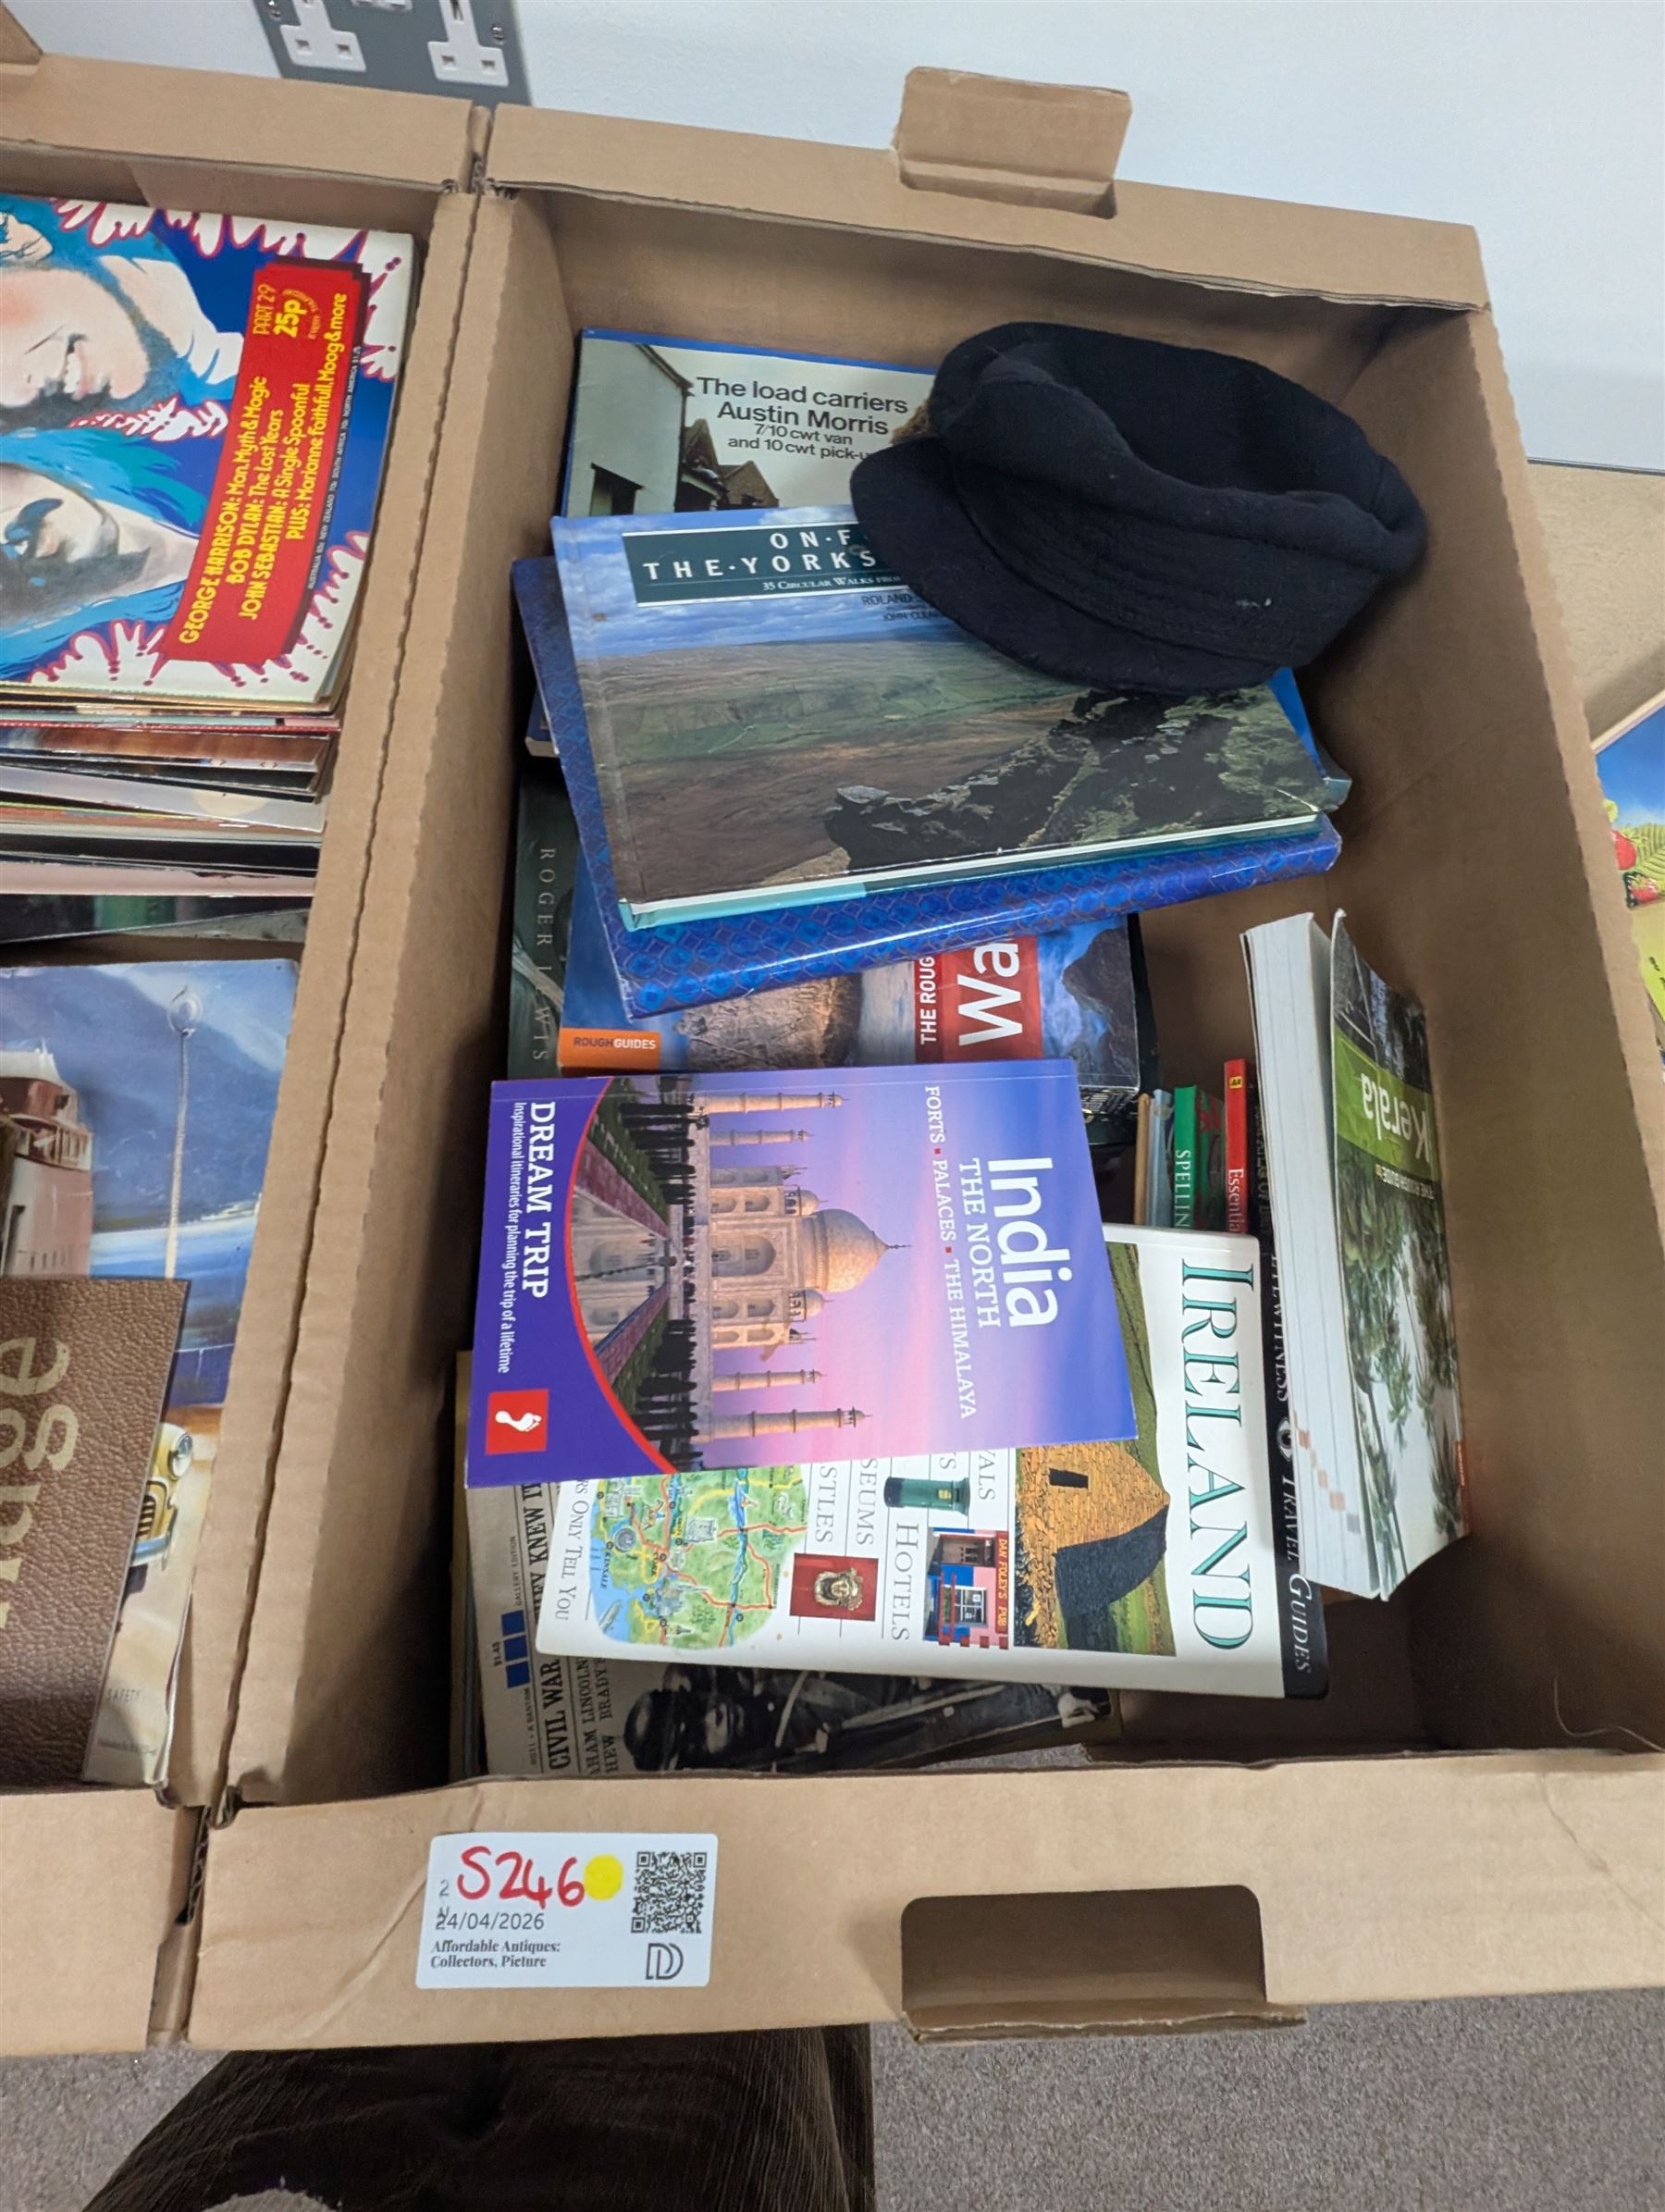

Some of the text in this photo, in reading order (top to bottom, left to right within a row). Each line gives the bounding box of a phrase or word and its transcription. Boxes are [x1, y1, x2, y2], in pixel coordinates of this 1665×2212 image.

[256, 283, 277, 303] 29
[329, 292, 348, 330] more
[273, 299, 308, 339] 25p
[317, 343, 346, 381] Moog
[347, 365, 358, 393] AMERICA
[281, 382, 311, 447] Spoonful
[342, 394, 352, 417] NORTH
[696, 377, 909, 414] The load carriers
[259, 409, 285, 446] Years
[717, 401, 889, 436] Austin Morris
[754, 423, 853, 446] 7/10 cwt van
[335, 431, 347, 456] AFRICA
[727, 438, 759, 451] and
[764, 439, 783, 452] 10
[784, 444, 816, 456] cwt
[247, 473, 270, 498] The
[294, 438, 324, 501] Marianne
[331, 457, 342, 478] SOUTH
[178, 576, 221, 645] GEORGE
[203, 496, 241, 575] HARRISON:
[240, 375, 271, 417] Magic
[271, 488, 291, 500] A
[323, 493, 336, 524] ZEALAND
[236, 499, 265, 546] DYLAN:
[251, 500, 288, 580] SEBASTIAN:
[285, 502, 313, 540] PLUS:
[318, 524, 329, 540] NEW
[225, 548, 253, 585] BOB
[307, 555, 322, 589] AUSTRALIA
[238, 581, 268, 620] JOHN
[762, 581, 776, 592] 35
[532, 847, 556, 1062] ROGER LWIS
[918, 955, 937, 1045] THE ROUG
[956, 943, 1024, 1047] Wa
[511, 1102, 527, 1158] Inspirational
[1360, 1072, 1430, 1164] Kerala
[509, 1160, 525, 1207] itineraries
[522, 1101, 556, 1299] DREAM TRIP
[1174, 1149, 1192, 1228] SPELLIN
[509, 1209, 524, 1223] for
[501, 1225, 522, 1268] planning
[925, 1085, 978, 1419] FORTS PALACES THE HIMALAYA
[958, 1157, 1002, 1328] THE NORTH
[988, 1156, 1073, 1328] India
[503, 1270, 519, 1288] the
[500, 1290, 517, 1308] trip
[501, 1310, 516, 1321] of
[498, 1330, 515, 1374] lifetime
[1180, 1258, 1256, 1650] IRELAND
[524, 1506, 549, 1566] KNEW
[566, 1500, 590, 1540] ONLY
[1282, 1475, 1301, 1561] TRAVEL
[561, 1546, 584, 1580] TELL
[890, 1522, 920, 1642] HOTELS
[997, 1539, 1008, 1627] DAN FOLEY'S PUB
[554, 1586, 577, 1622] YOU
[1288, 1573, 1313, 1674] GUIDES
[539, 1659, 563, 1711] WAR
[544, 1710, 572, 1771] CIVIL
[457, 1845, 586, 1909] S246
[435, 1911, 546, 1931] 24/04/2026
[429, 1954, 548, 1969] Collectors, Picture
[430, 1938, 561, 1955] Affordable Antiques:
